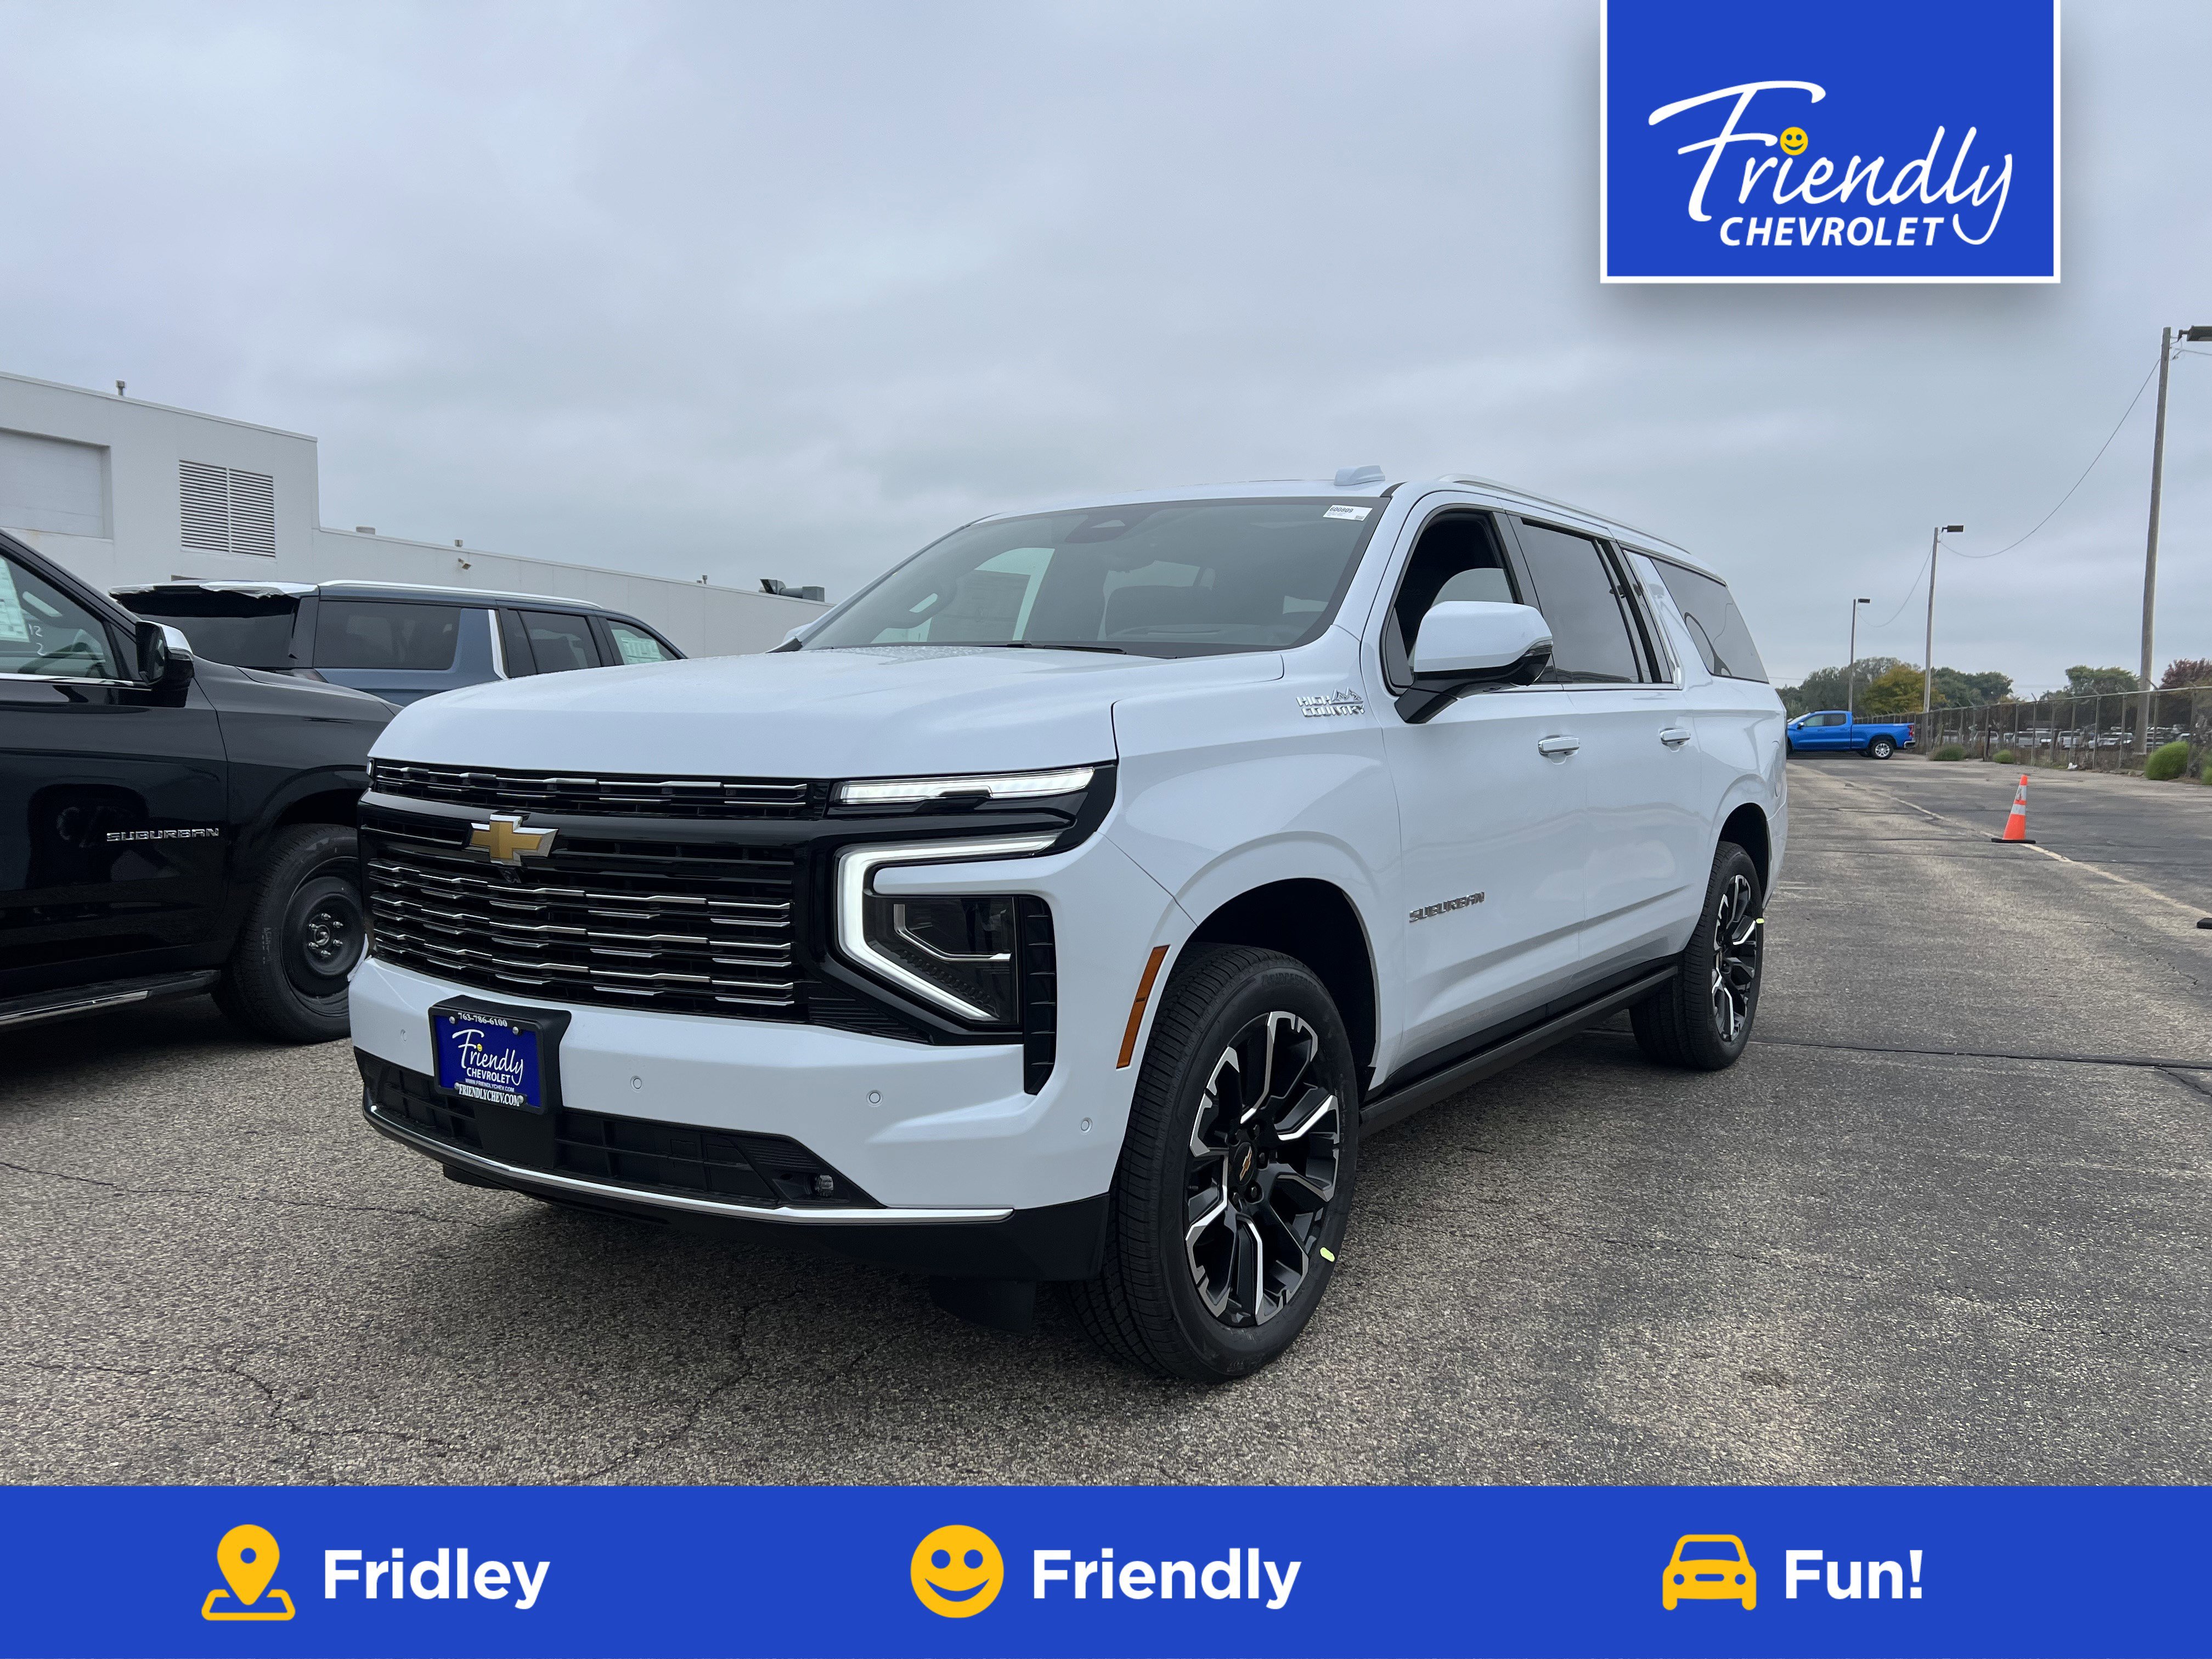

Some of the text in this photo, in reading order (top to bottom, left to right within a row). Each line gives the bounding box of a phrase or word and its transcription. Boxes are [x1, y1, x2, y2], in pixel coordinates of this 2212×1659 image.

[1295, 695, 1333, 707] HIGH
[1301, 704, 1365, 718] COUNTRY
[106, 828, 219, 842] SUBURBAN
[1409, 891, 1485, 923] SUBURBAN
[458, 1012, 508, 1028] 763-786-6100
[452, 1029, 523, 1086] Friendly
[466, 1067, 511, 1084] CHEVROLET
[458, 1083, 520, 1107] FRIENDLYCHEV.COM
